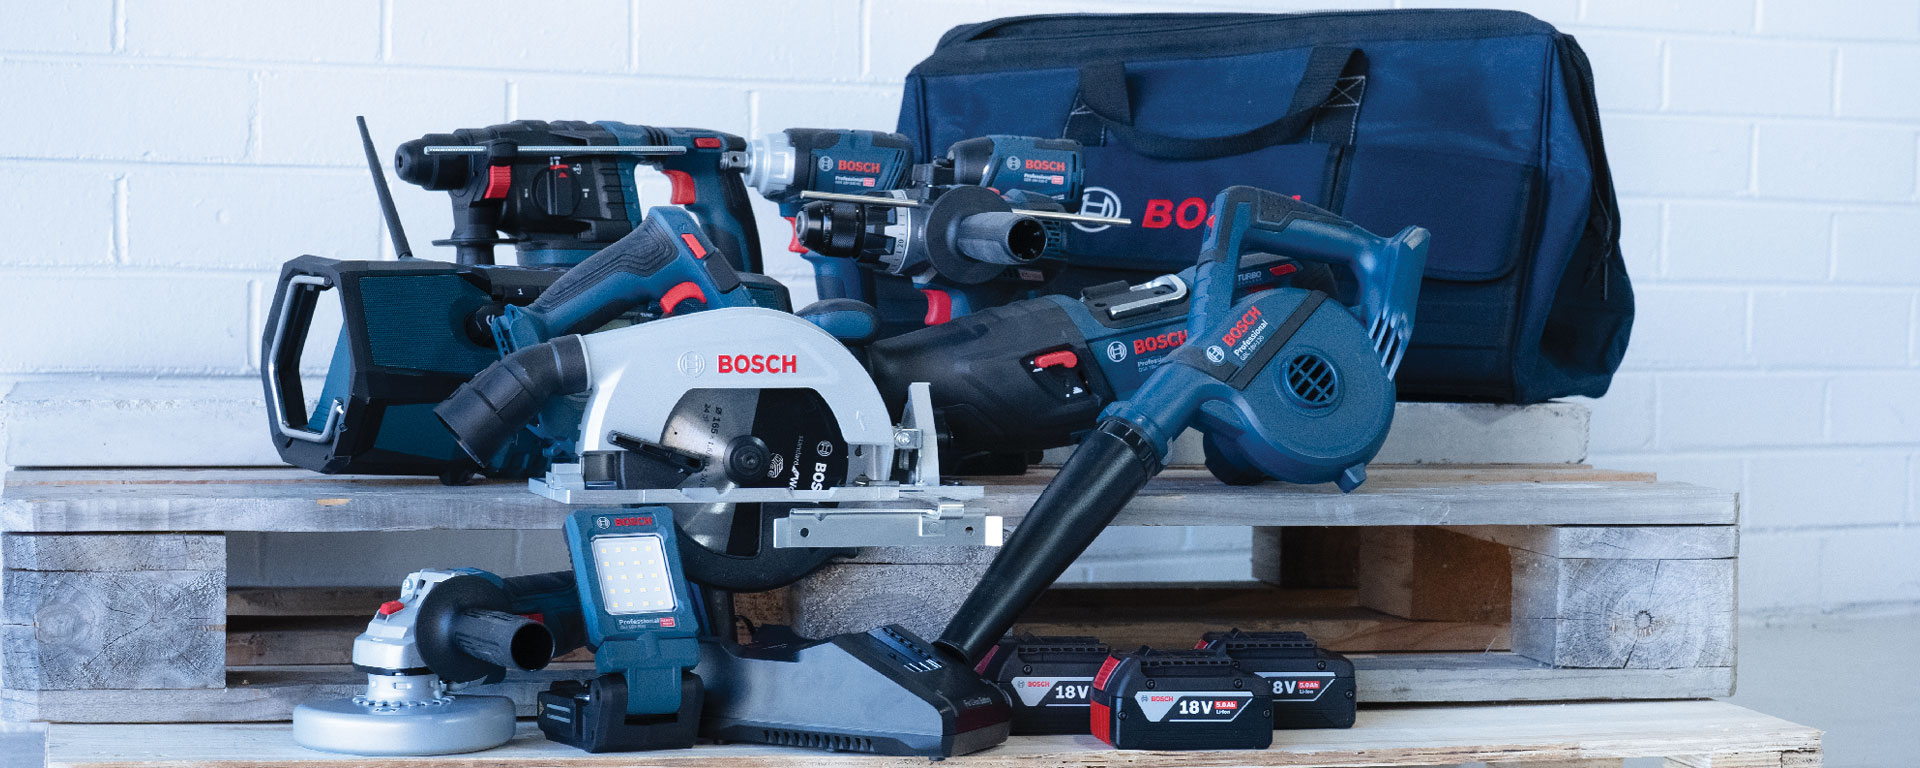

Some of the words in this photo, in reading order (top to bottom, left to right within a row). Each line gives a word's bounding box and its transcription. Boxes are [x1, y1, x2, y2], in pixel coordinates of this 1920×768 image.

[838, 159, 881, 174] BOSCH
[1025, 159, 1066, 172] BOSCH
[896, 239, 905, 248] 20
[1237, 270, 1262, 282] TURBO
[517, 287, 524, 296] 1
[1222, 305, 1263, 348] BOSCH
[1133, 329, 1188, 355] BOSCH
[1233, 318, 1269, 357] Professional
[718, 354, 797, 374] BOSCH
[710, 416, 721, 435] 165
[793, 435, 805, 466] standard
[614, 516, 653, 527] BOSCH
[1055, 685, 1089, 699] 18V
[1267, 680, 1297, 694] 8V
[1179, 699, 1214, 715] 18V
